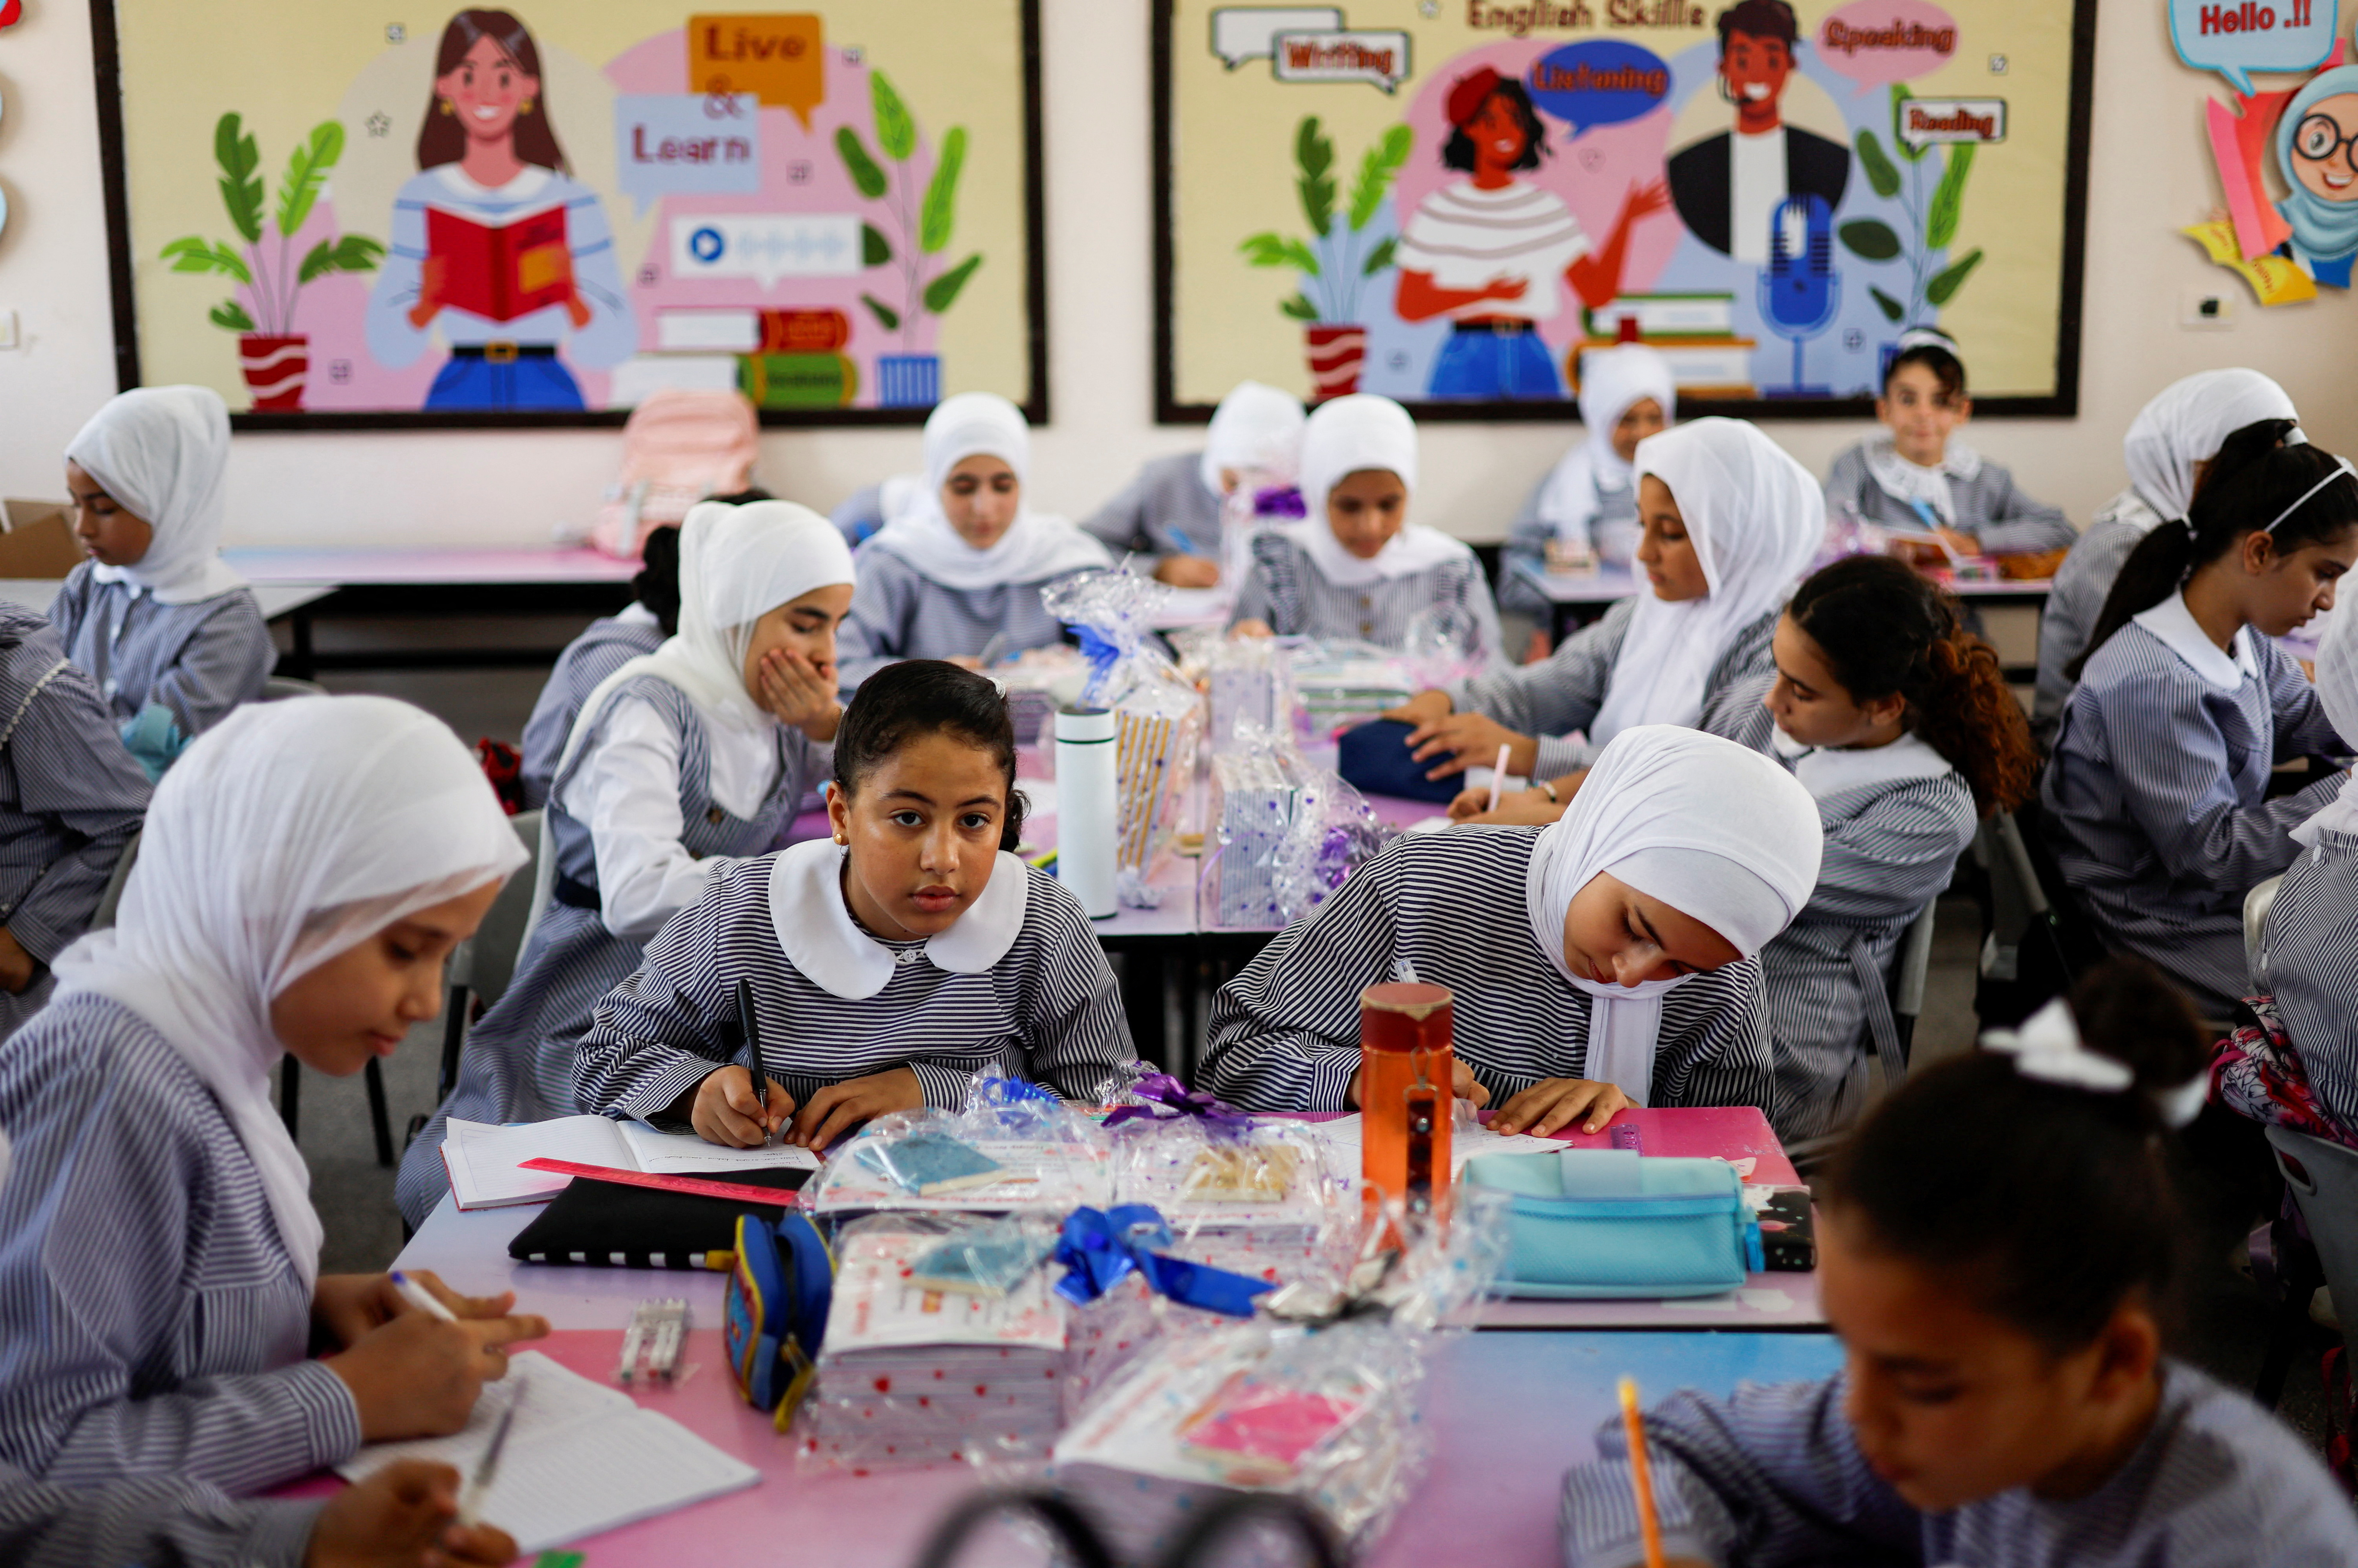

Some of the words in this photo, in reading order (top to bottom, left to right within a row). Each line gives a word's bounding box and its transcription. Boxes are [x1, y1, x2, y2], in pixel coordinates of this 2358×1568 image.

[1468, 0, 1592, 34] English
[1606, 0, 1705, 29] Skills
[2200, 3, 2275, 35] Hello
[703, 24, 807, 62] Live
[1824, 18, 1955, 56] Speaking
[1288, 41, 1394, 74] Writing
[703, 74, 745, 120] &
[1532, 62, 1669, 97] Listening
[1909, 107, 1995, 138] Reading
[632, 123, 750, 164] Learn
